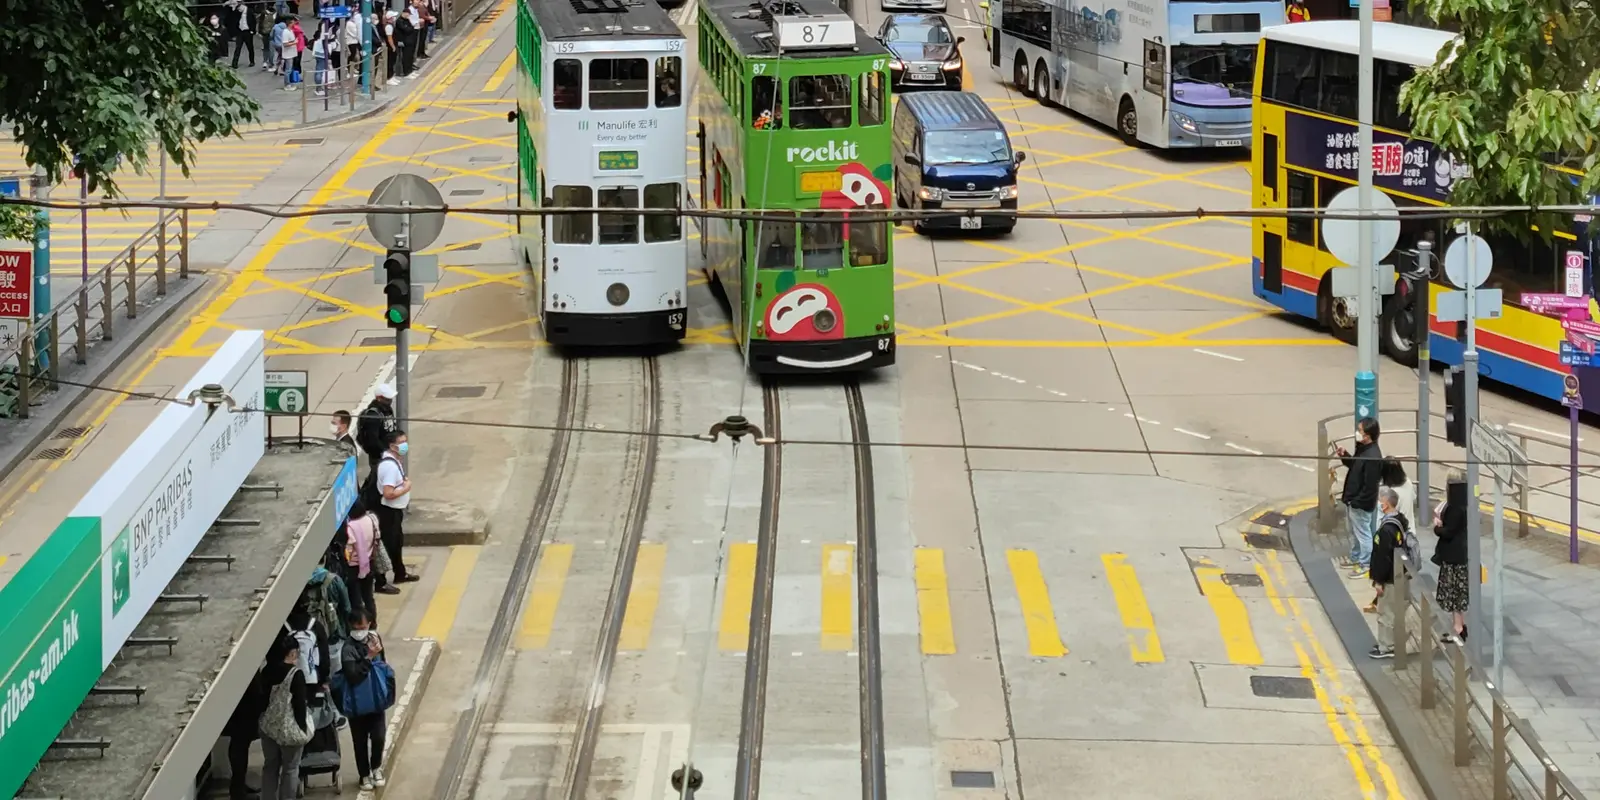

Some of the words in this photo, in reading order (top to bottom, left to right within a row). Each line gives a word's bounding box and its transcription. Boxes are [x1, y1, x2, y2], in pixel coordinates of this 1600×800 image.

[802, 24, 830, 43] 87
[558, 42, 575, 53] 159
[665, 40, 680, 51] 159
[752, 63, 767, 74] 87
[871, 59, 886, 71] 87
[597, 121, 636, 130] Manulife
[638, 119, 657, 129] 宏利
[597, 134, 614, 142] Every
[615, 134, 627, 142] day
[628, 133, 648, 141] better
[786, 140, 860, 163] rockit
[1568, 270, 1580, 294] 中環
[668, 312, 683, 325] 159
[878, 338, 890, 351] 87
[133, 507, 153, 553] BNP
[155, 458, 193, 525] PARIBAS
[0, 609, 79, 739] ribas-am.hk
